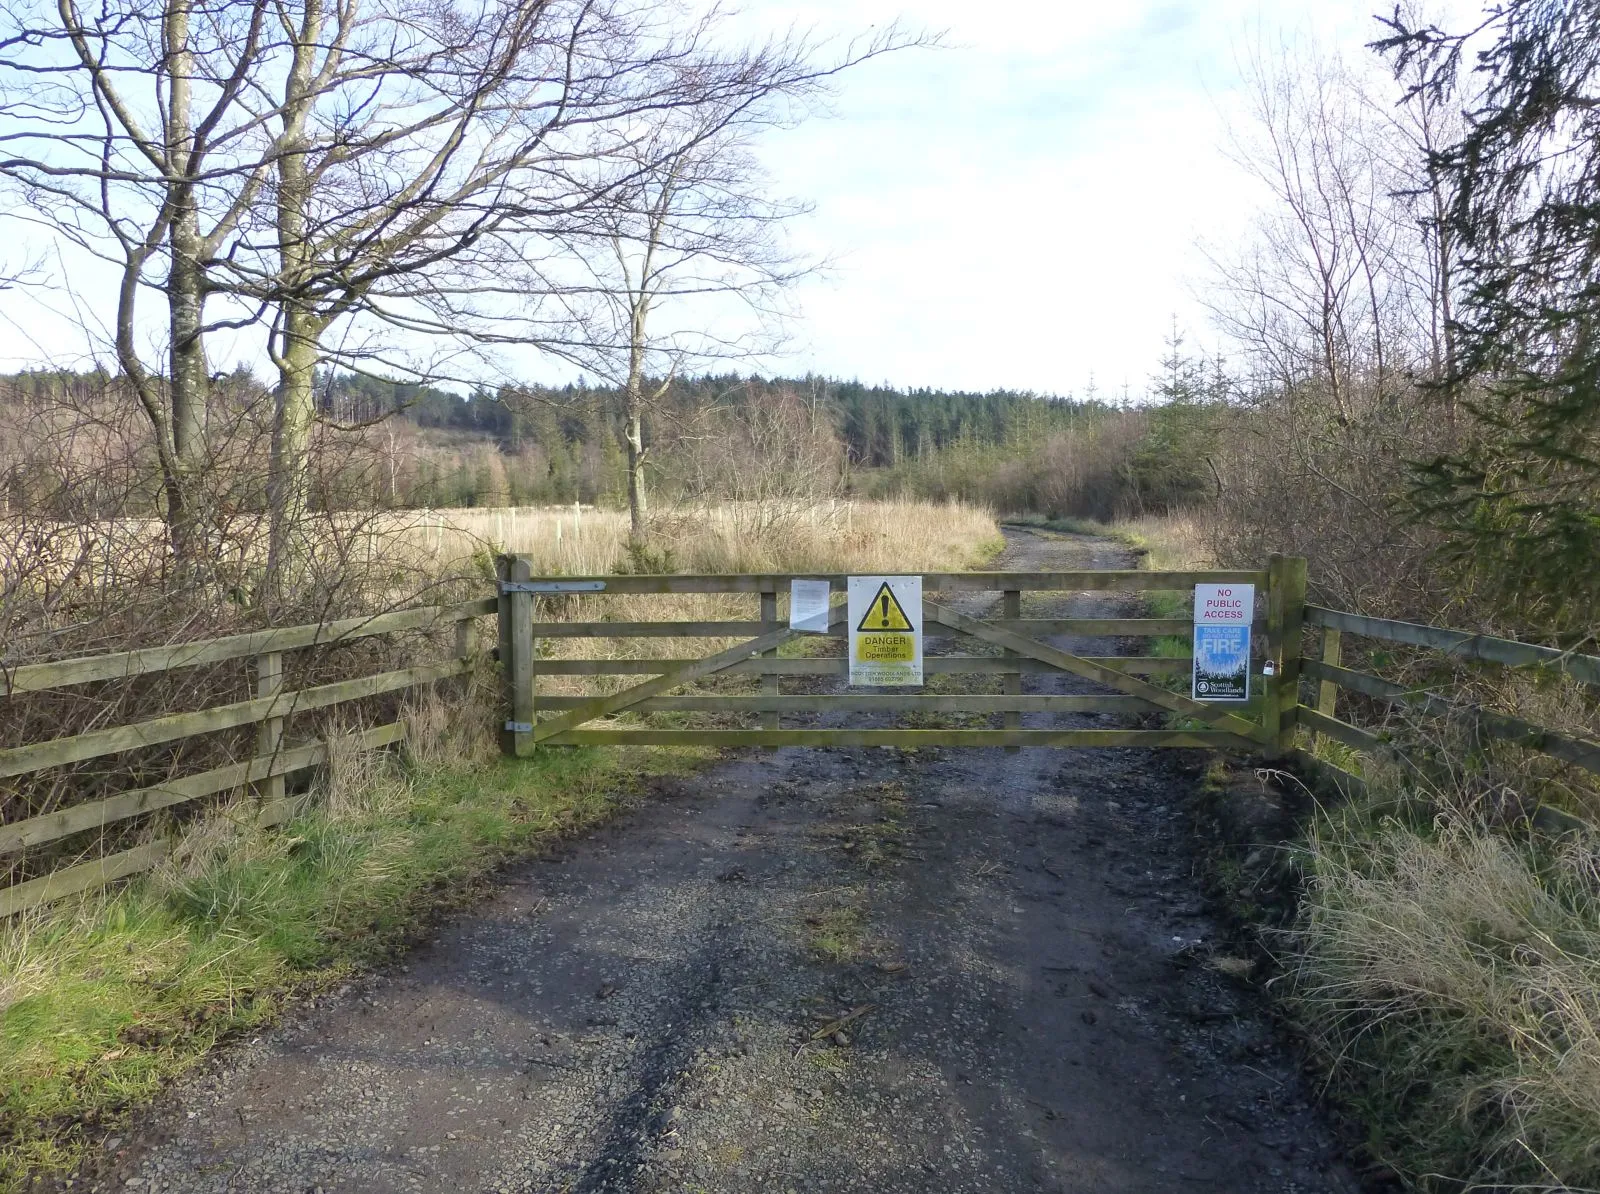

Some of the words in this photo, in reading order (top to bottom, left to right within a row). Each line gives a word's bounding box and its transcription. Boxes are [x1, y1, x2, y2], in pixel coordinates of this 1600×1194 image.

[1217, 589, 1232, 597] NO
[1206, 600, 1242, 608] PUBLIC
[1203, 610, 1243, 618] ACCESS
[864, 637, 906, 645] DANGER
[1203, 639, 1242, 654] FIRE
[865, 652, 906, 660] Operations
[1210, 686, 1244, 694] Woodlands
